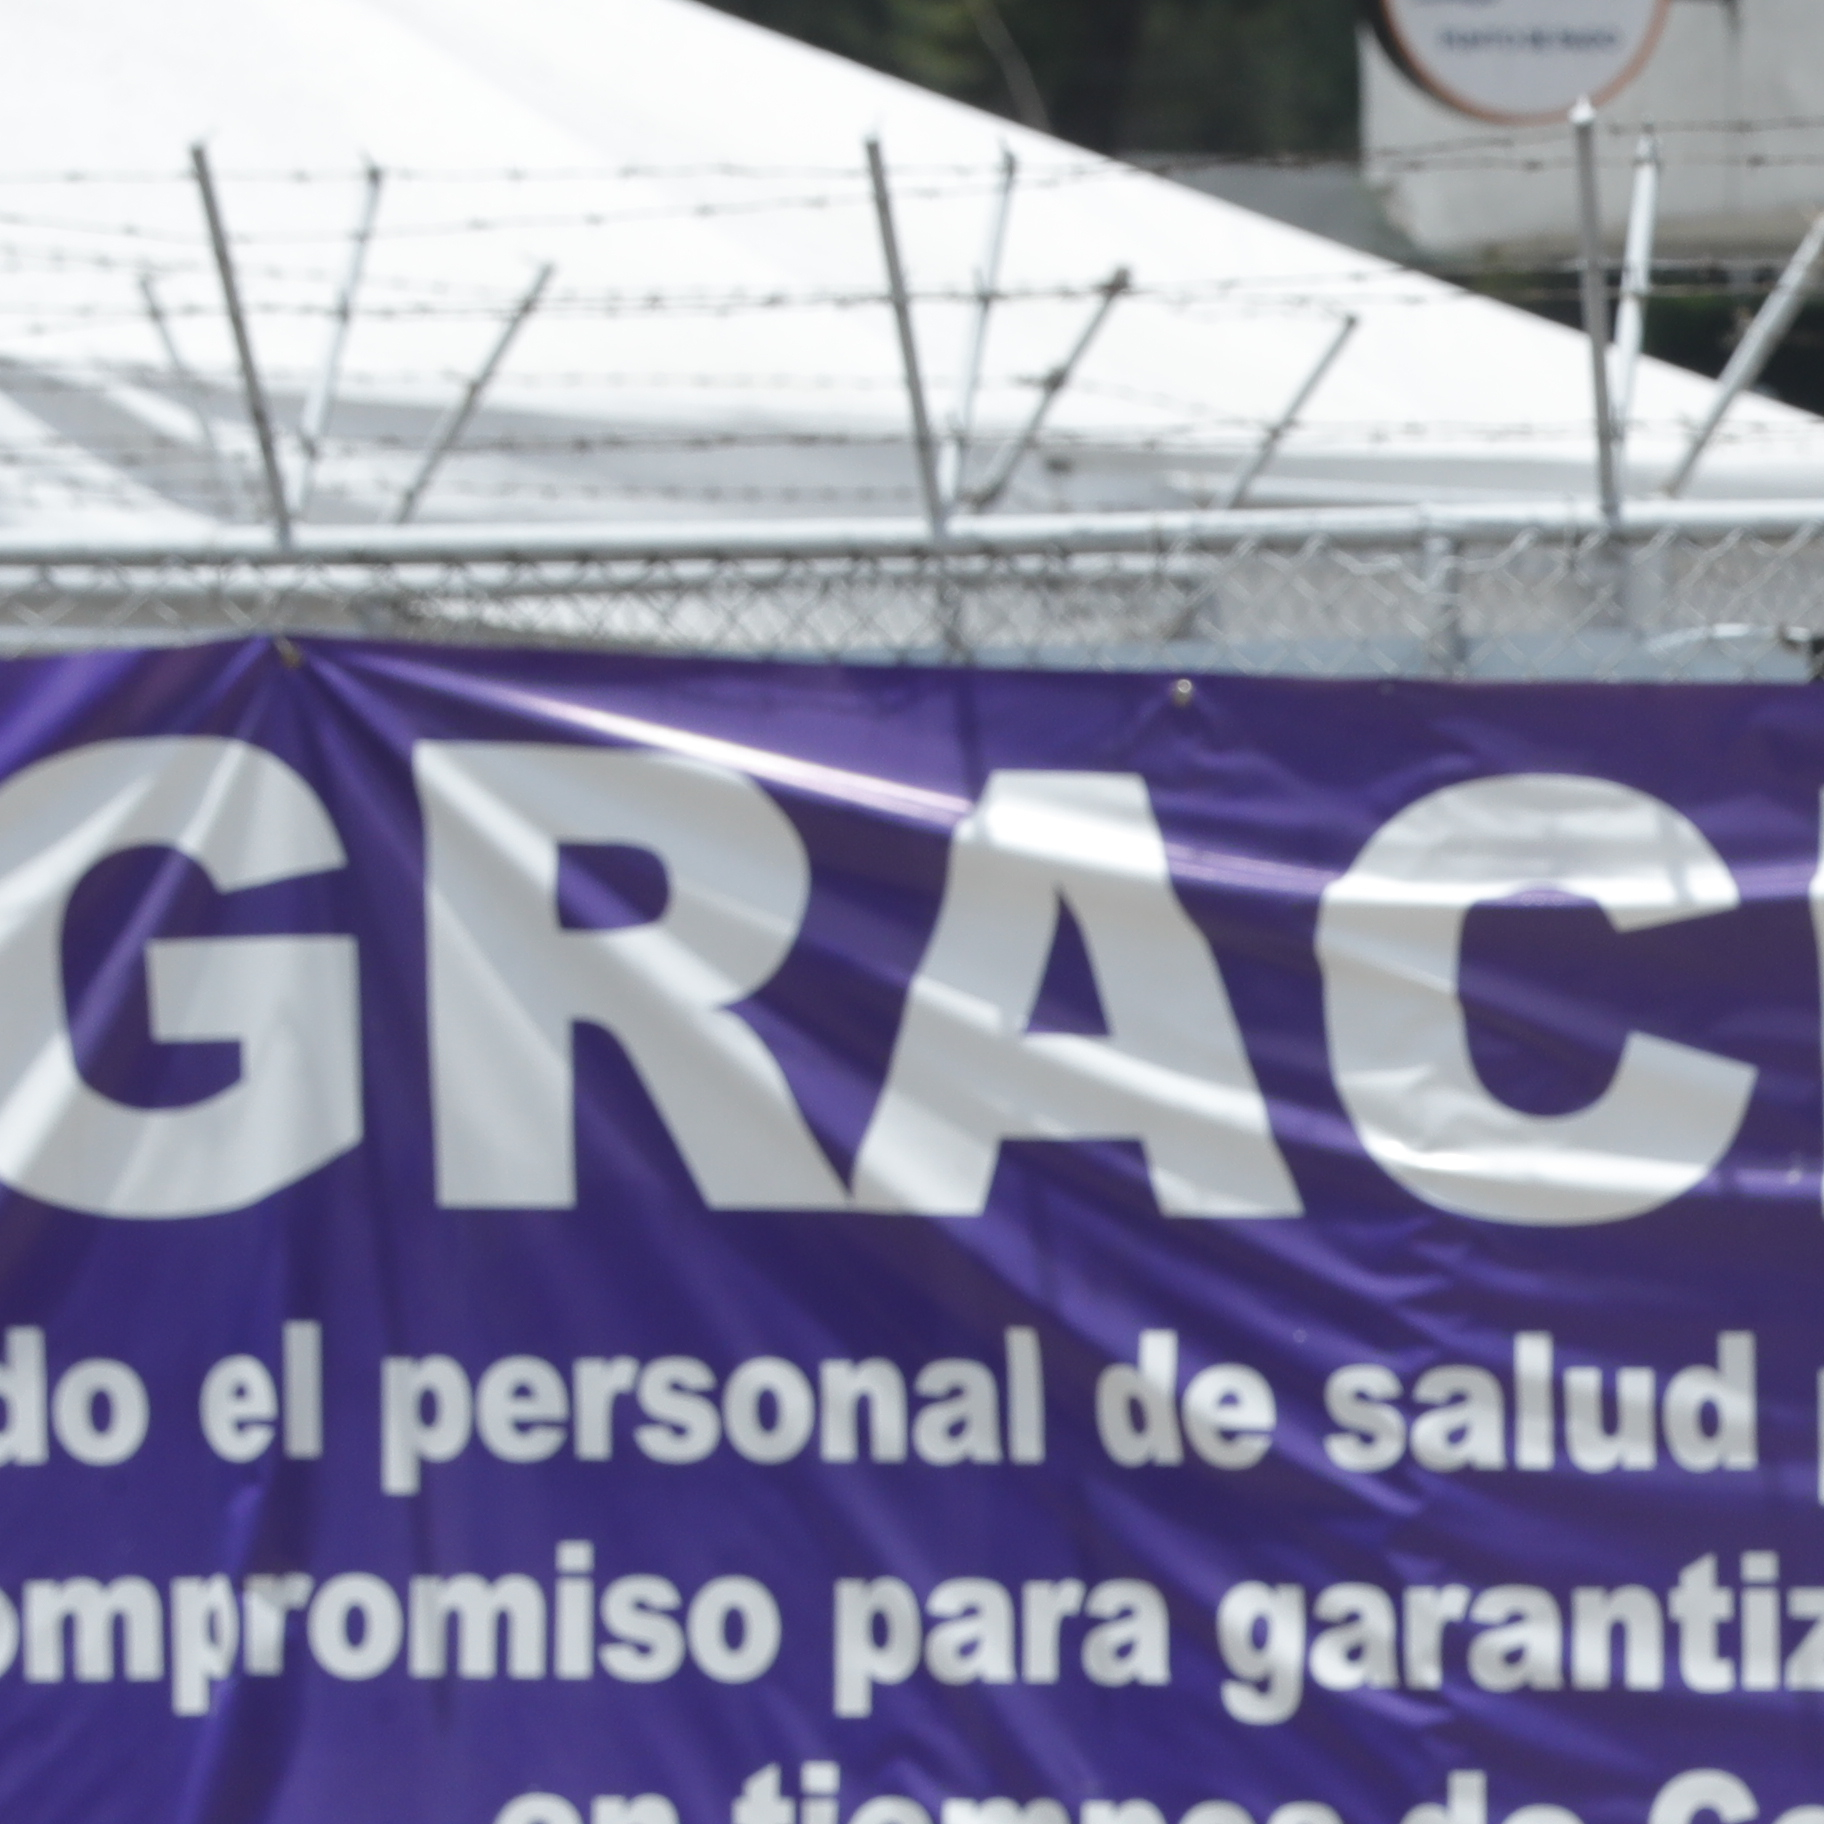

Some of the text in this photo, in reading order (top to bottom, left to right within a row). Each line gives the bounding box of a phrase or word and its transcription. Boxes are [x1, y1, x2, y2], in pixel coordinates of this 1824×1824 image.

[200, 1321, 322, 1461] el
[382, 1327, 1044, 1494] personal
[1098, 1328, 1278, 1467] de
[1324, 1332, 1757, 1473] salud
[0, 1541, 781, 1715] mpromiso
[834, 1577, 1170, 1717] para
